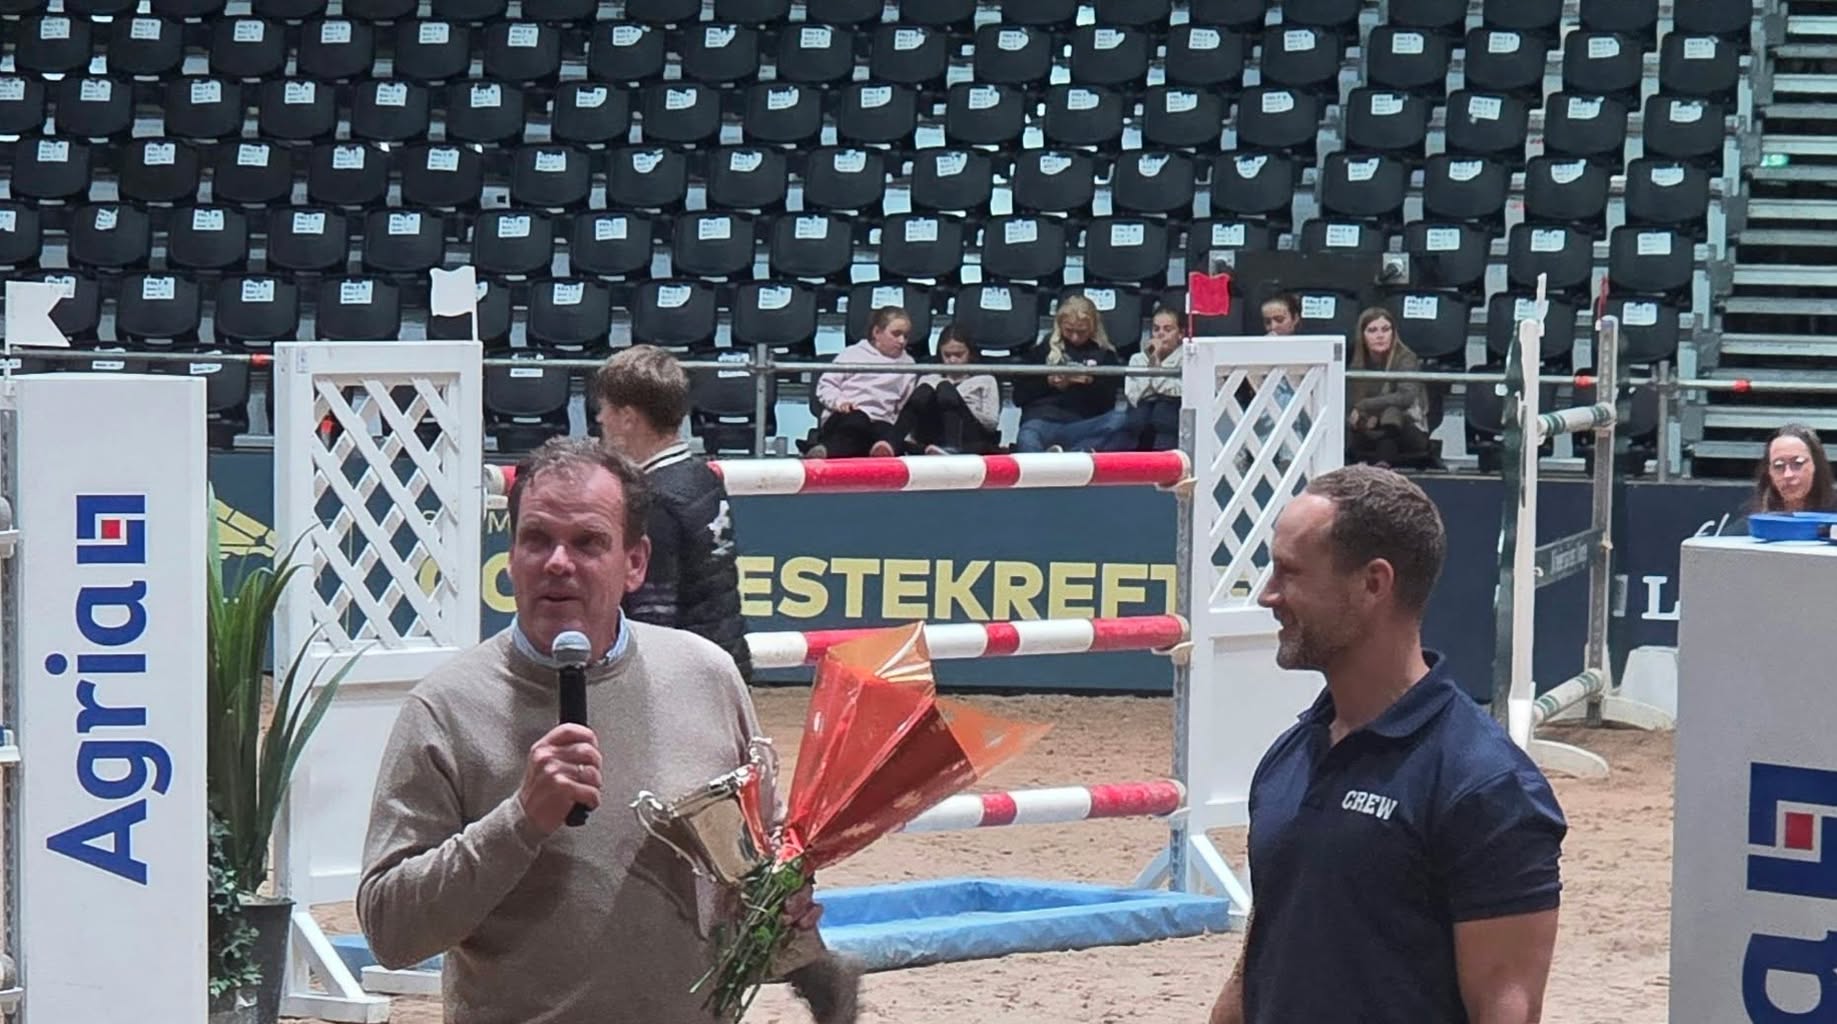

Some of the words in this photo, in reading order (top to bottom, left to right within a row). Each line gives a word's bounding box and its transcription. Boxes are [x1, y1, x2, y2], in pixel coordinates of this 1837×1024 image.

[737, 557, 1250, 620] ESTEKREFT
[45, 580, 173, 886] Agria
[1341, 790, 1398, 820] CREW
